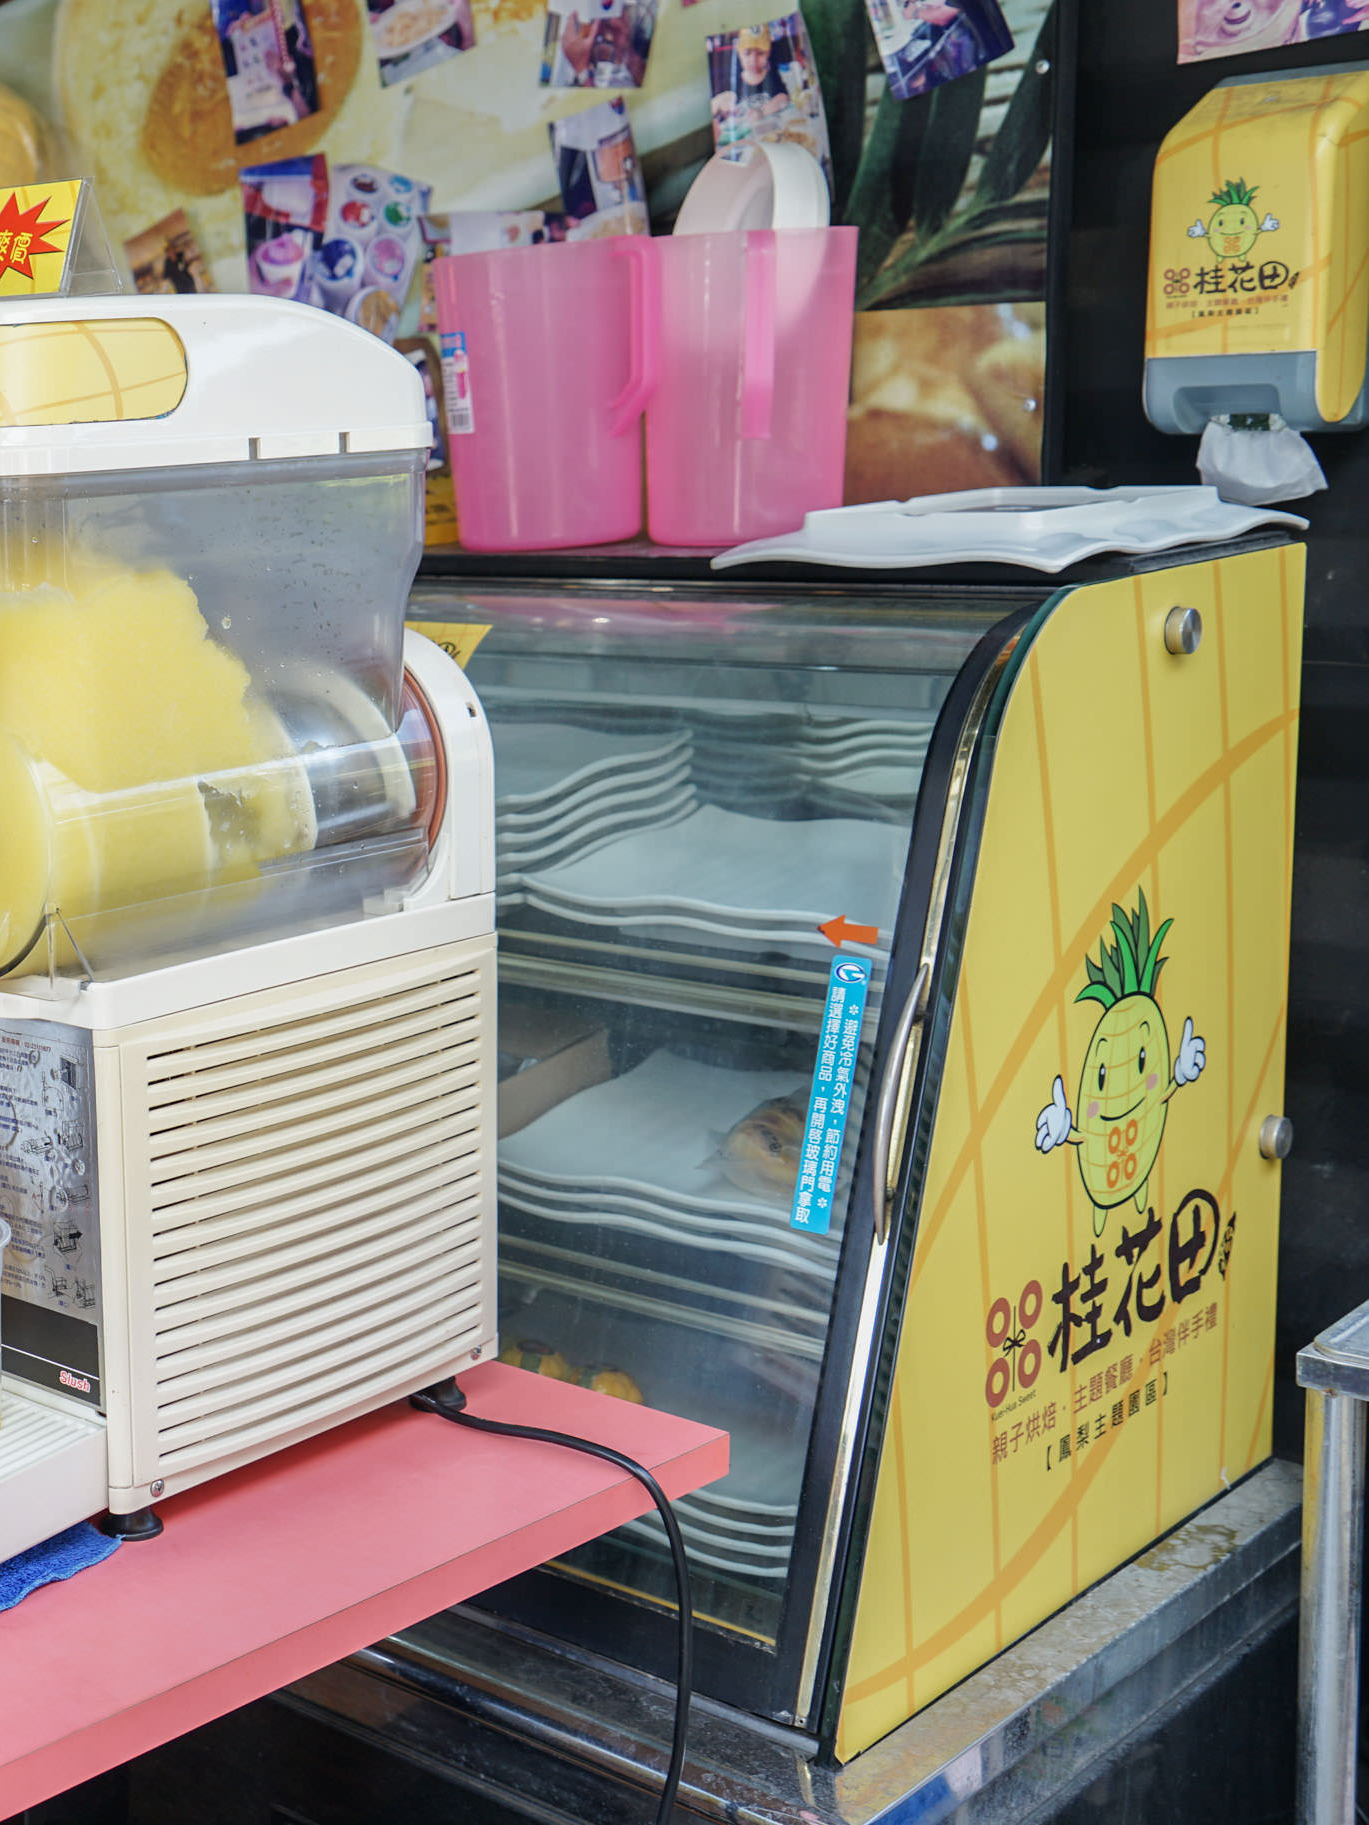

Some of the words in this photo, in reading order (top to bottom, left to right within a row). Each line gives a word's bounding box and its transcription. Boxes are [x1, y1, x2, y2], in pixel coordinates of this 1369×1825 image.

[1193, 261, 1289, 294] 桂花田
[1047, 1188, 1220, 1373] 桂花田
[59, 1370, 91, 1393] Slush
